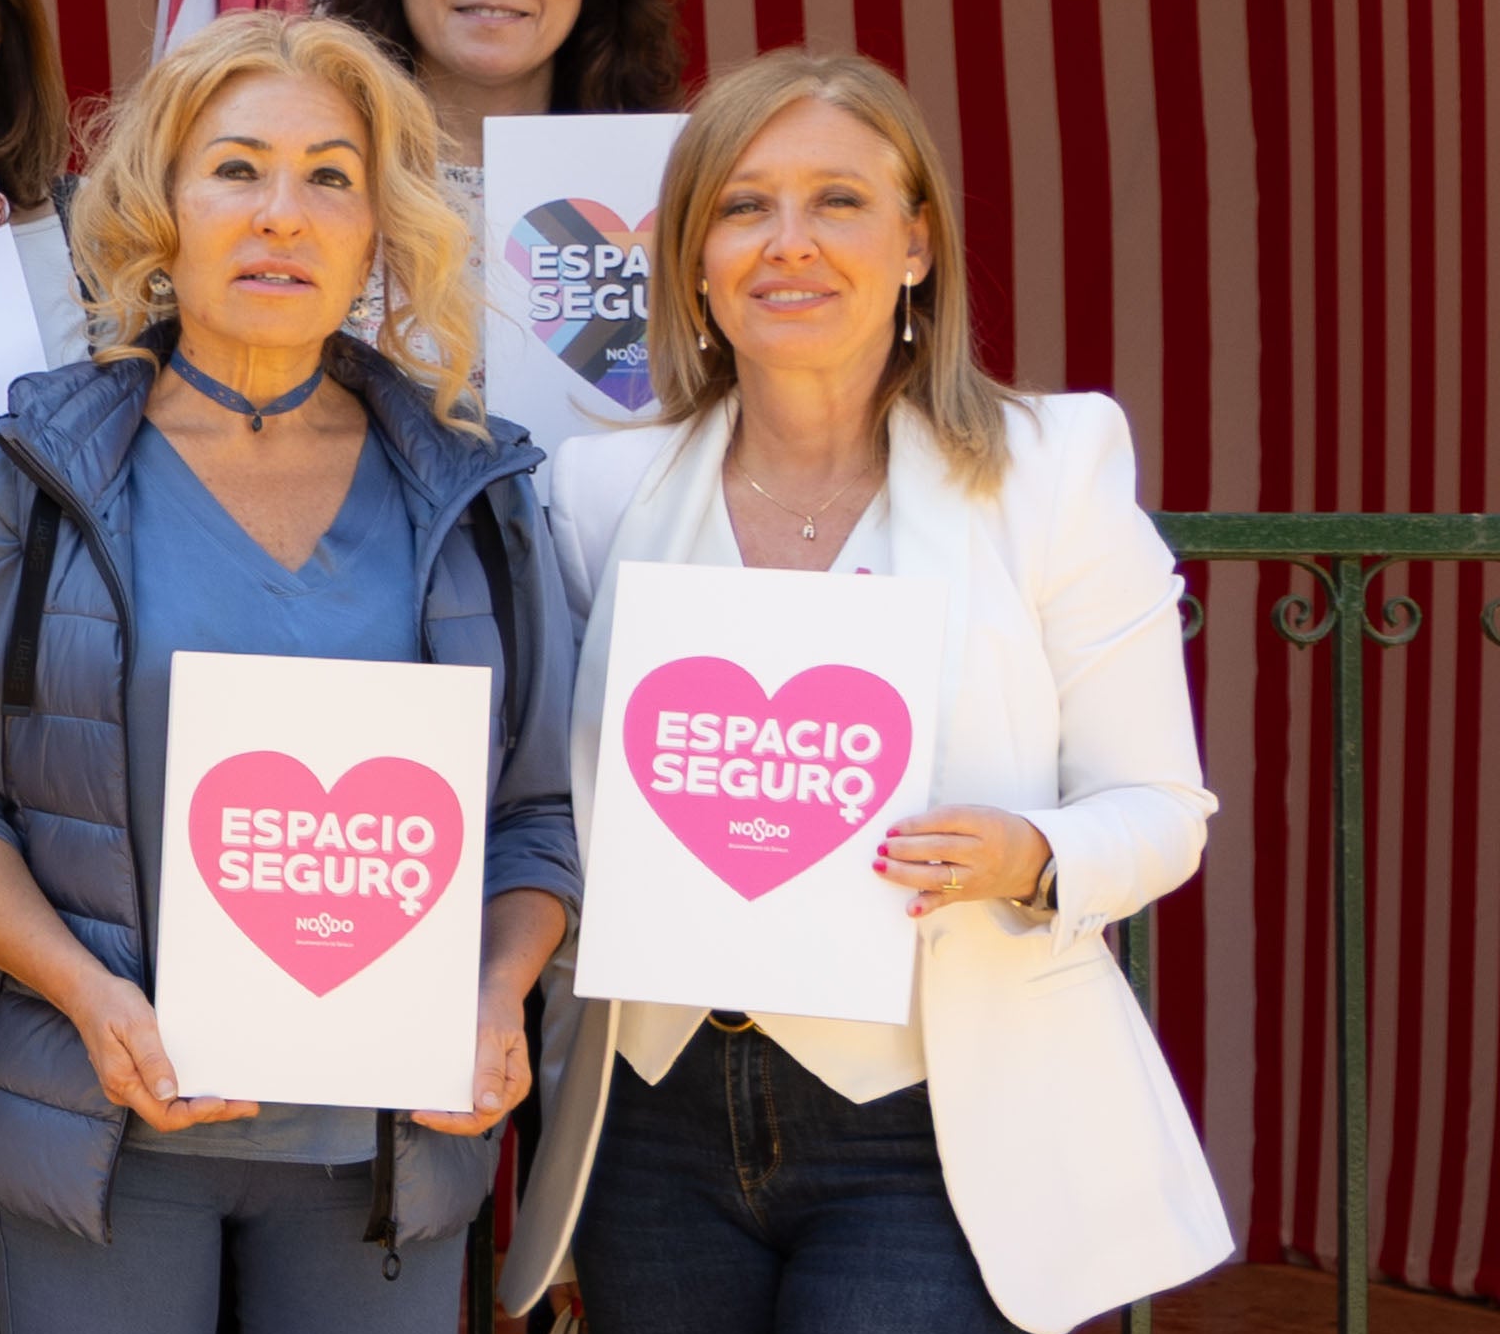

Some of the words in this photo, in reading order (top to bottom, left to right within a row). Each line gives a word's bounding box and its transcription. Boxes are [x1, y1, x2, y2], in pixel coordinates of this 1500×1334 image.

[530, 244, 650, 280] ESPA
[656, 711, 882, 764] ESPACIO
[651, 753, 875, 824] SEGURO
[221, 807, 435, 856] ESPACIO
[218, 849, 431, 916] SEGURO
